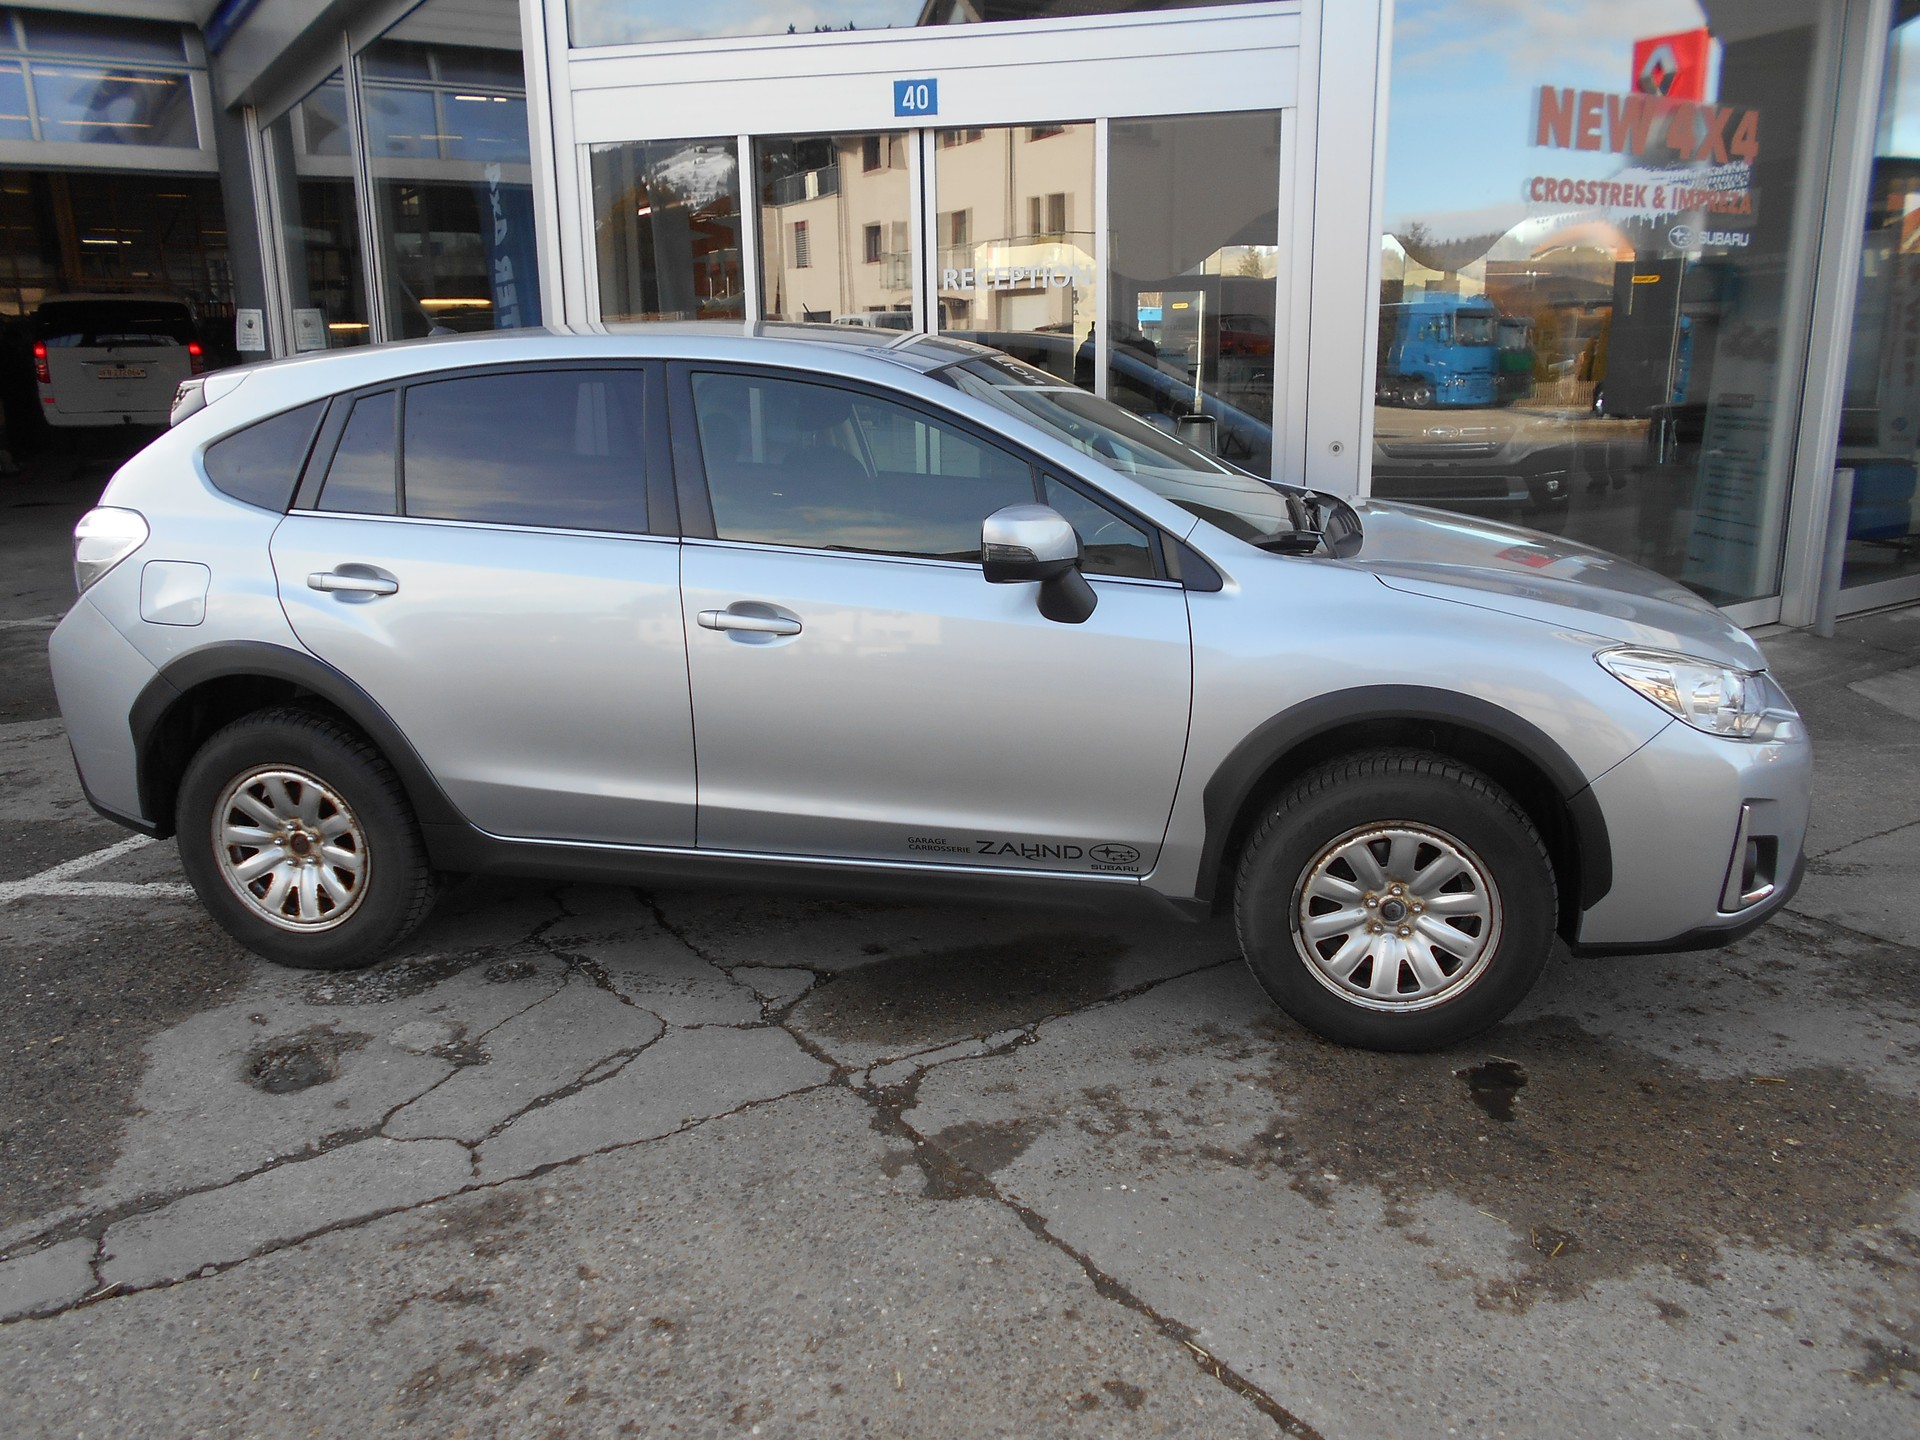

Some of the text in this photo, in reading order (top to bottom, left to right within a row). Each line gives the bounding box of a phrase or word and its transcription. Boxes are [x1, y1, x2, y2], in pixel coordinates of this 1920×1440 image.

[902, 84, 929, 110] 40
[1537, 85, 1654, 157] NEW
[1530, 176, 1752, 215] CROSSTREK & IMPREZA
[1699, 231, 1750, 247] SUBARU
[943, 264, 1092, 291] RECEPTION
[907, 836, 947, 845] GARAGE
[908, 844, 971, 853] CARROSSERIE
[976, 840, 1084, 861] ZAHND
[1090, 864, 1139, 872] SUBARU
